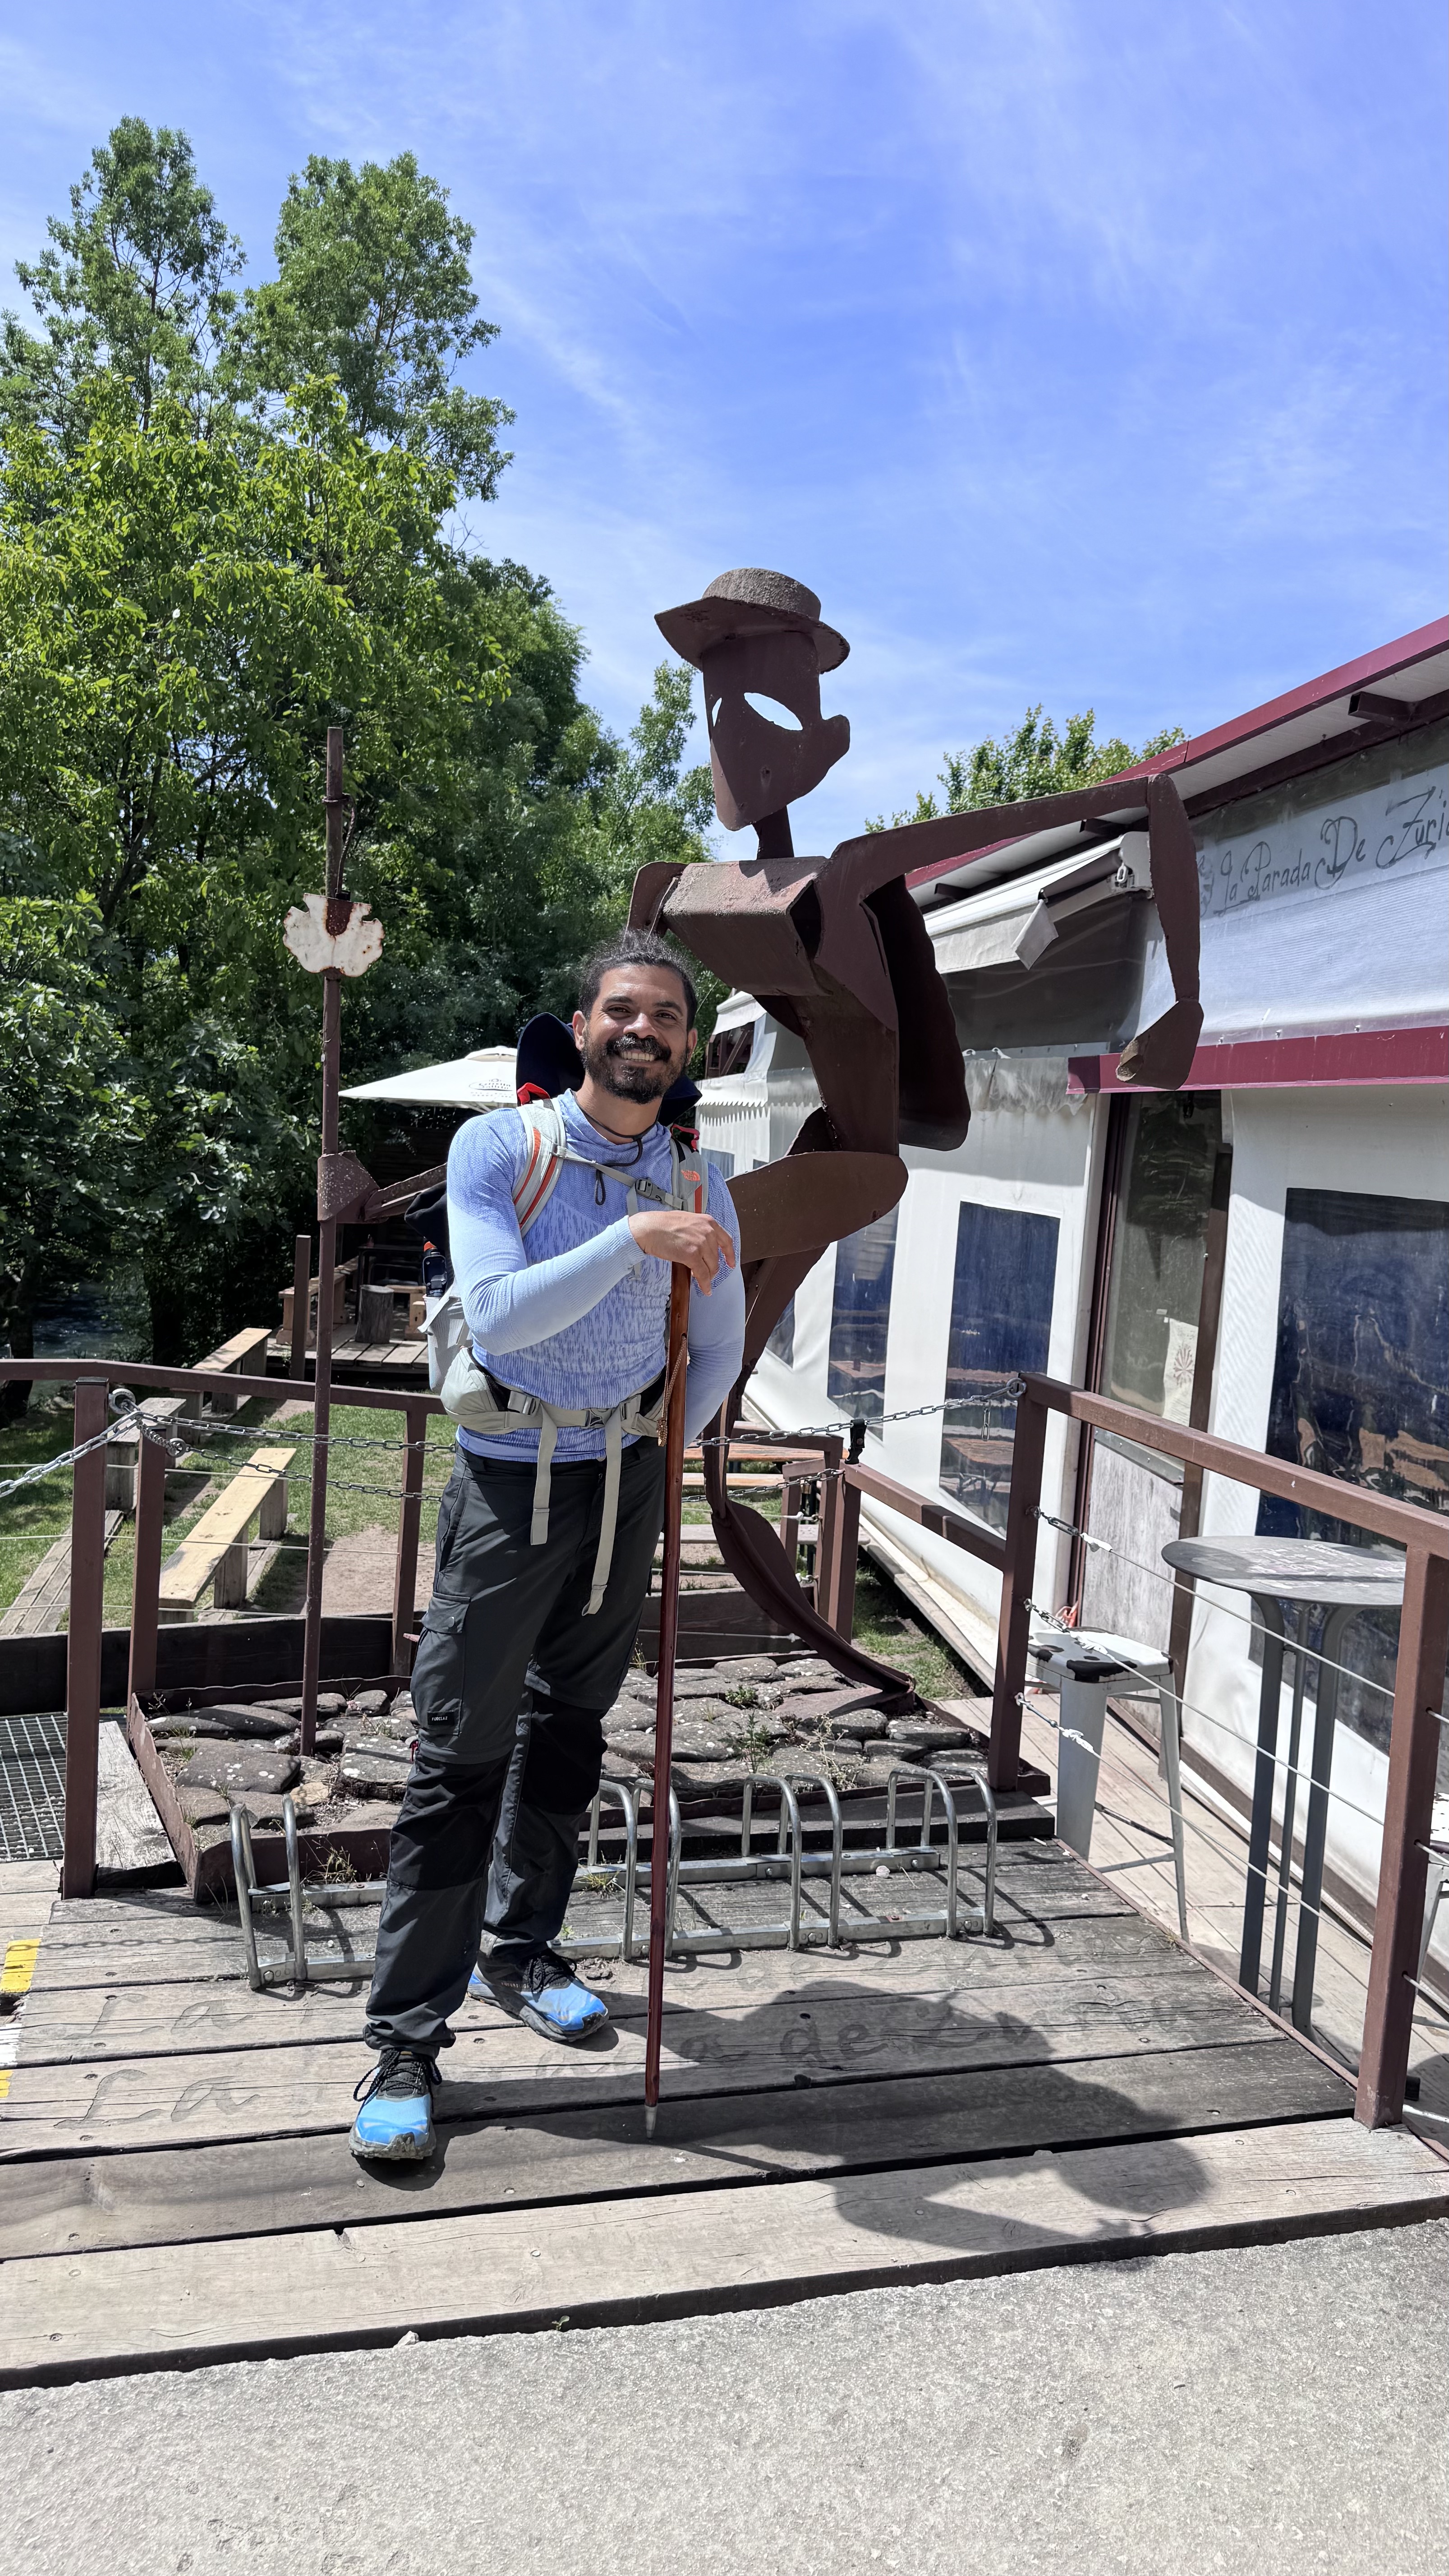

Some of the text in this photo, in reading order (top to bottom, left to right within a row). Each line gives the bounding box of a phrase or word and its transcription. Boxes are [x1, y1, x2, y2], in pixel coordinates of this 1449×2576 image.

[1241, 841, 1311, 902] Parada
[1314, 816, 1366, 890] De
[53, 2069, 260, 2128] La
[780, 2017, 889, 2065] de
